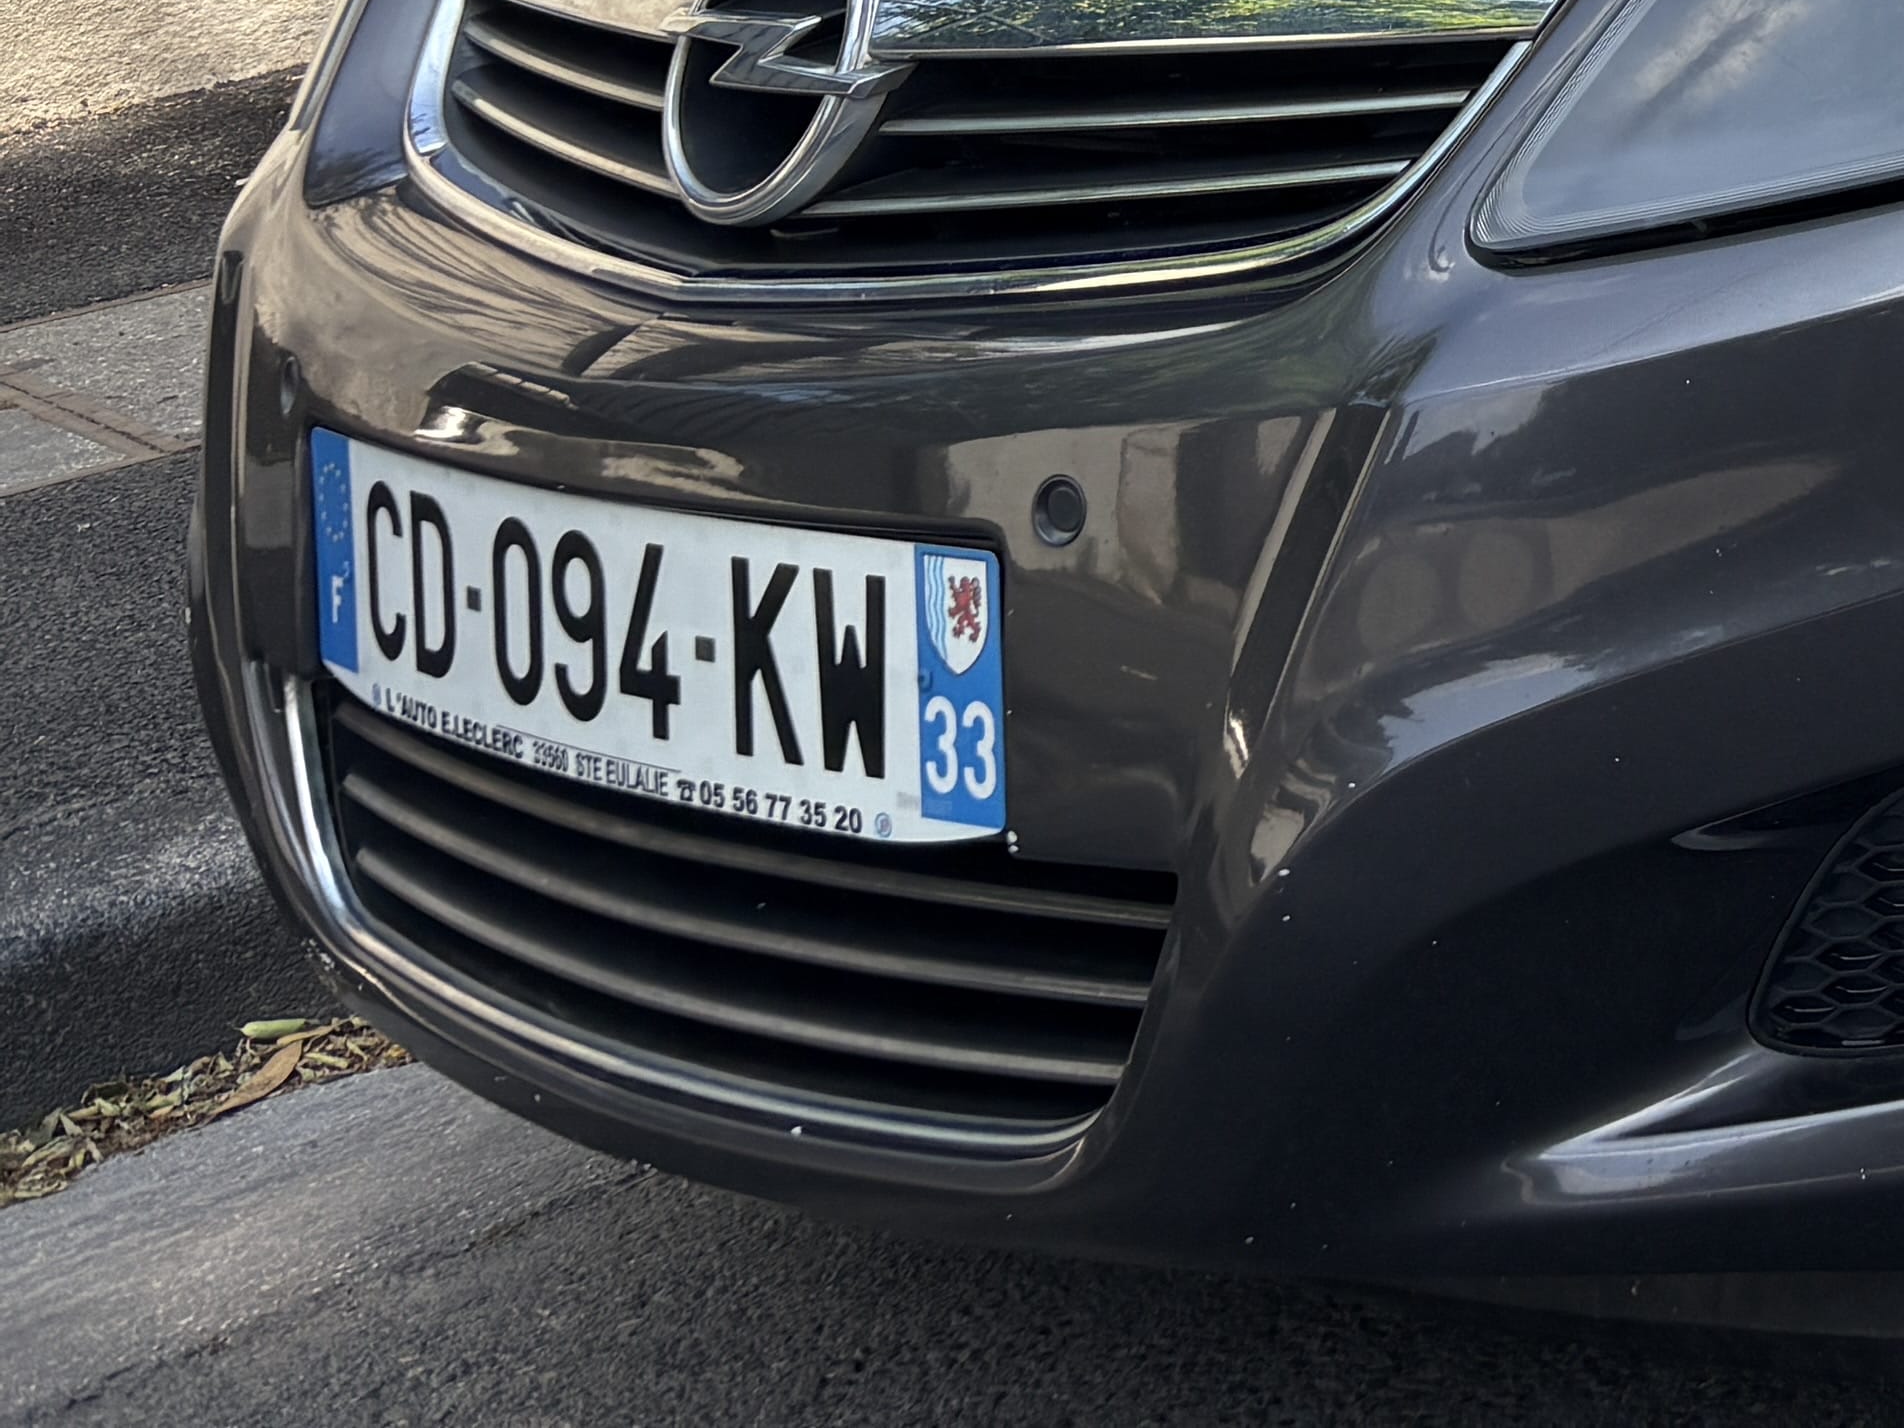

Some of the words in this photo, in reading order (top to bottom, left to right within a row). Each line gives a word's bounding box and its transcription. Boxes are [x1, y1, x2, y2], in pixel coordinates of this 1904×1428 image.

[329, 576, 344, 625] F
[366, 480, 886, 779] CD-094-KW
[575, 751, 602, 781] STE
[606, 758, 669, 796] EULALIE
[699, 779, 725, 809] 05
[732, 786, 759, 816] 56
[765, 792, 793, 822] 77
[799, 798, 828, 828] 35
[834, 804, 863, 835] 20
[923, 695, 998, 801] 33
